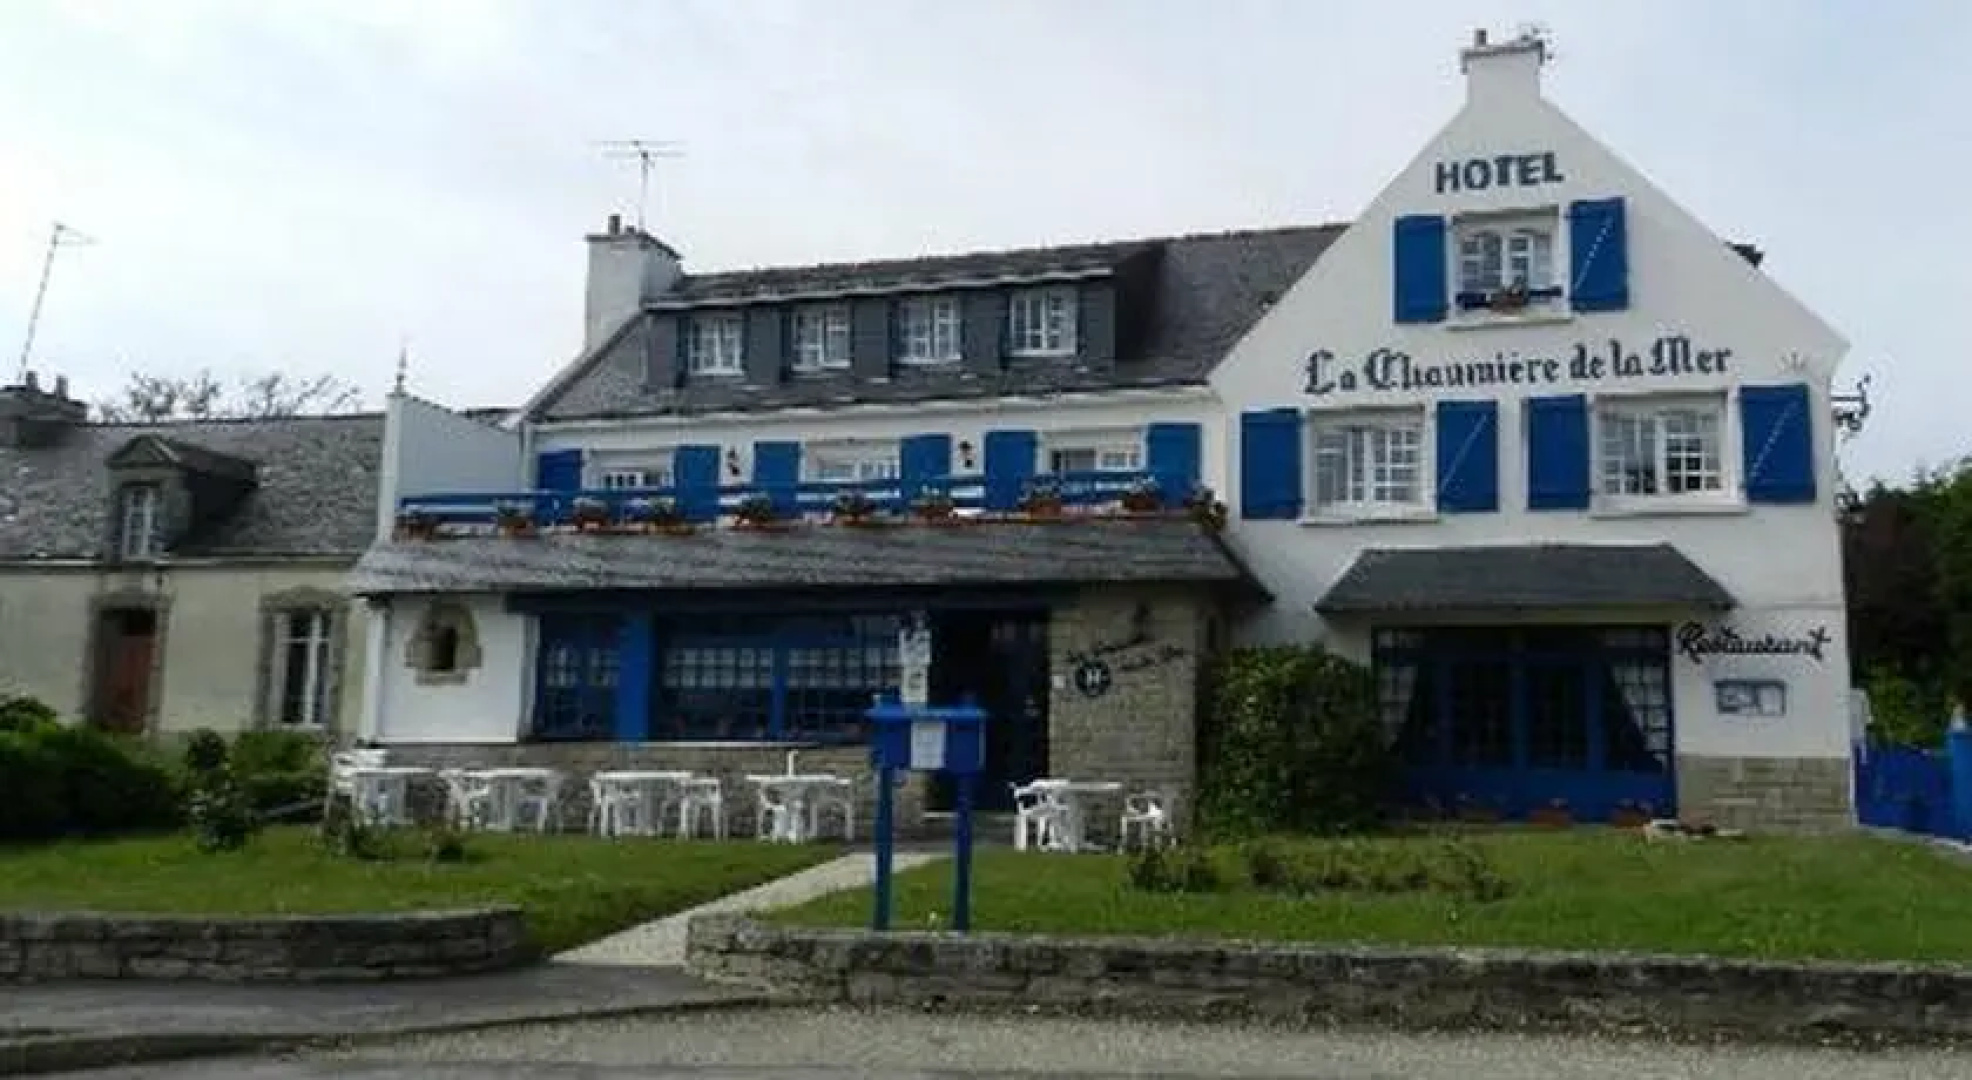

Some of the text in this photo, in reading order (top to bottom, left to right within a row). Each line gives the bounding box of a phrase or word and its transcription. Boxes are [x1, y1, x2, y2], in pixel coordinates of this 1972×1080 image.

[1435, 152, 1565, 194] HOTEL
[1304, 349, 1357, 394] La
[1569, 343, 1606, 380] de
[1608, 337, 1644, 377] la
[1648, 335, 1732, 376] Mer
[1676, 621, 1832, 664] Restaurant
